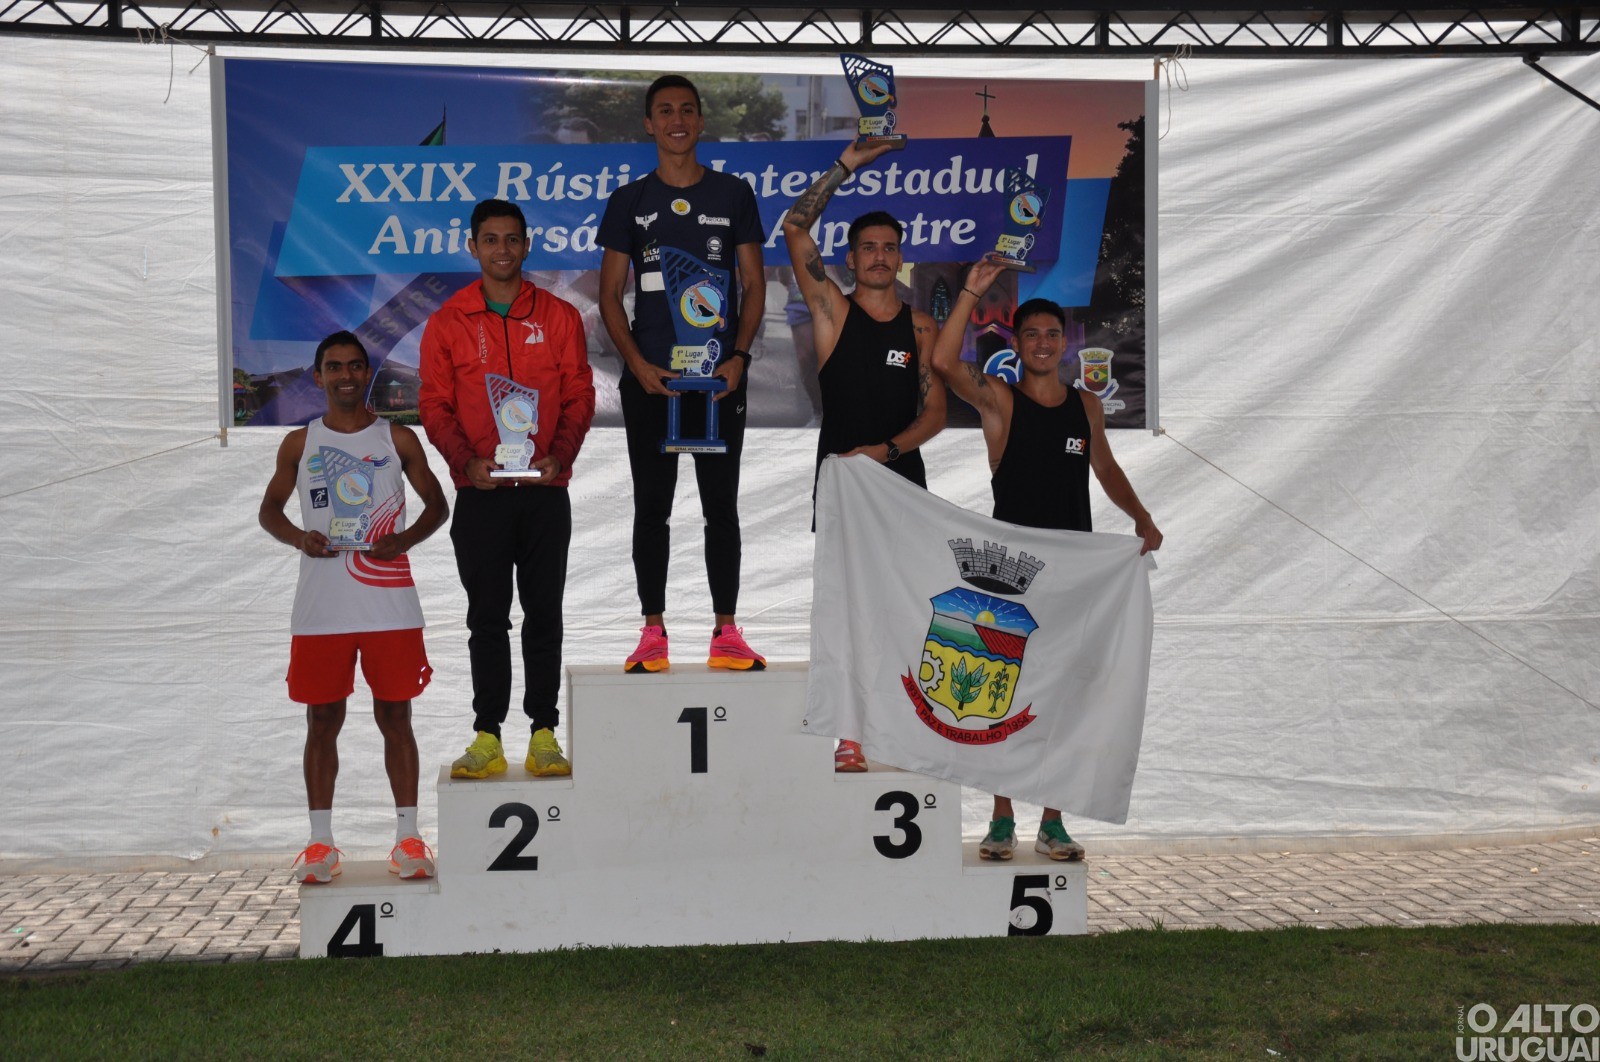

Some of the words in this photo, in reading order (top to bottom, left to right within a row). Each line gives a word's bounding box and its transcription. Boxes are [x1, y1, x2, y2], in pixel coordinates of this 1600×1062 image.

[336, 162, 476, 202] XXIX
[494, 161, 649, 201] Rústi
[1007, 238, 1022, 246] Lugar
[685, 350, 703, 359] Lugar
[920, 708, 937, 727] PAZ
[945, 727, 1002, 742] TRABALHO
[1007, 715, 1030, 732] 1954
